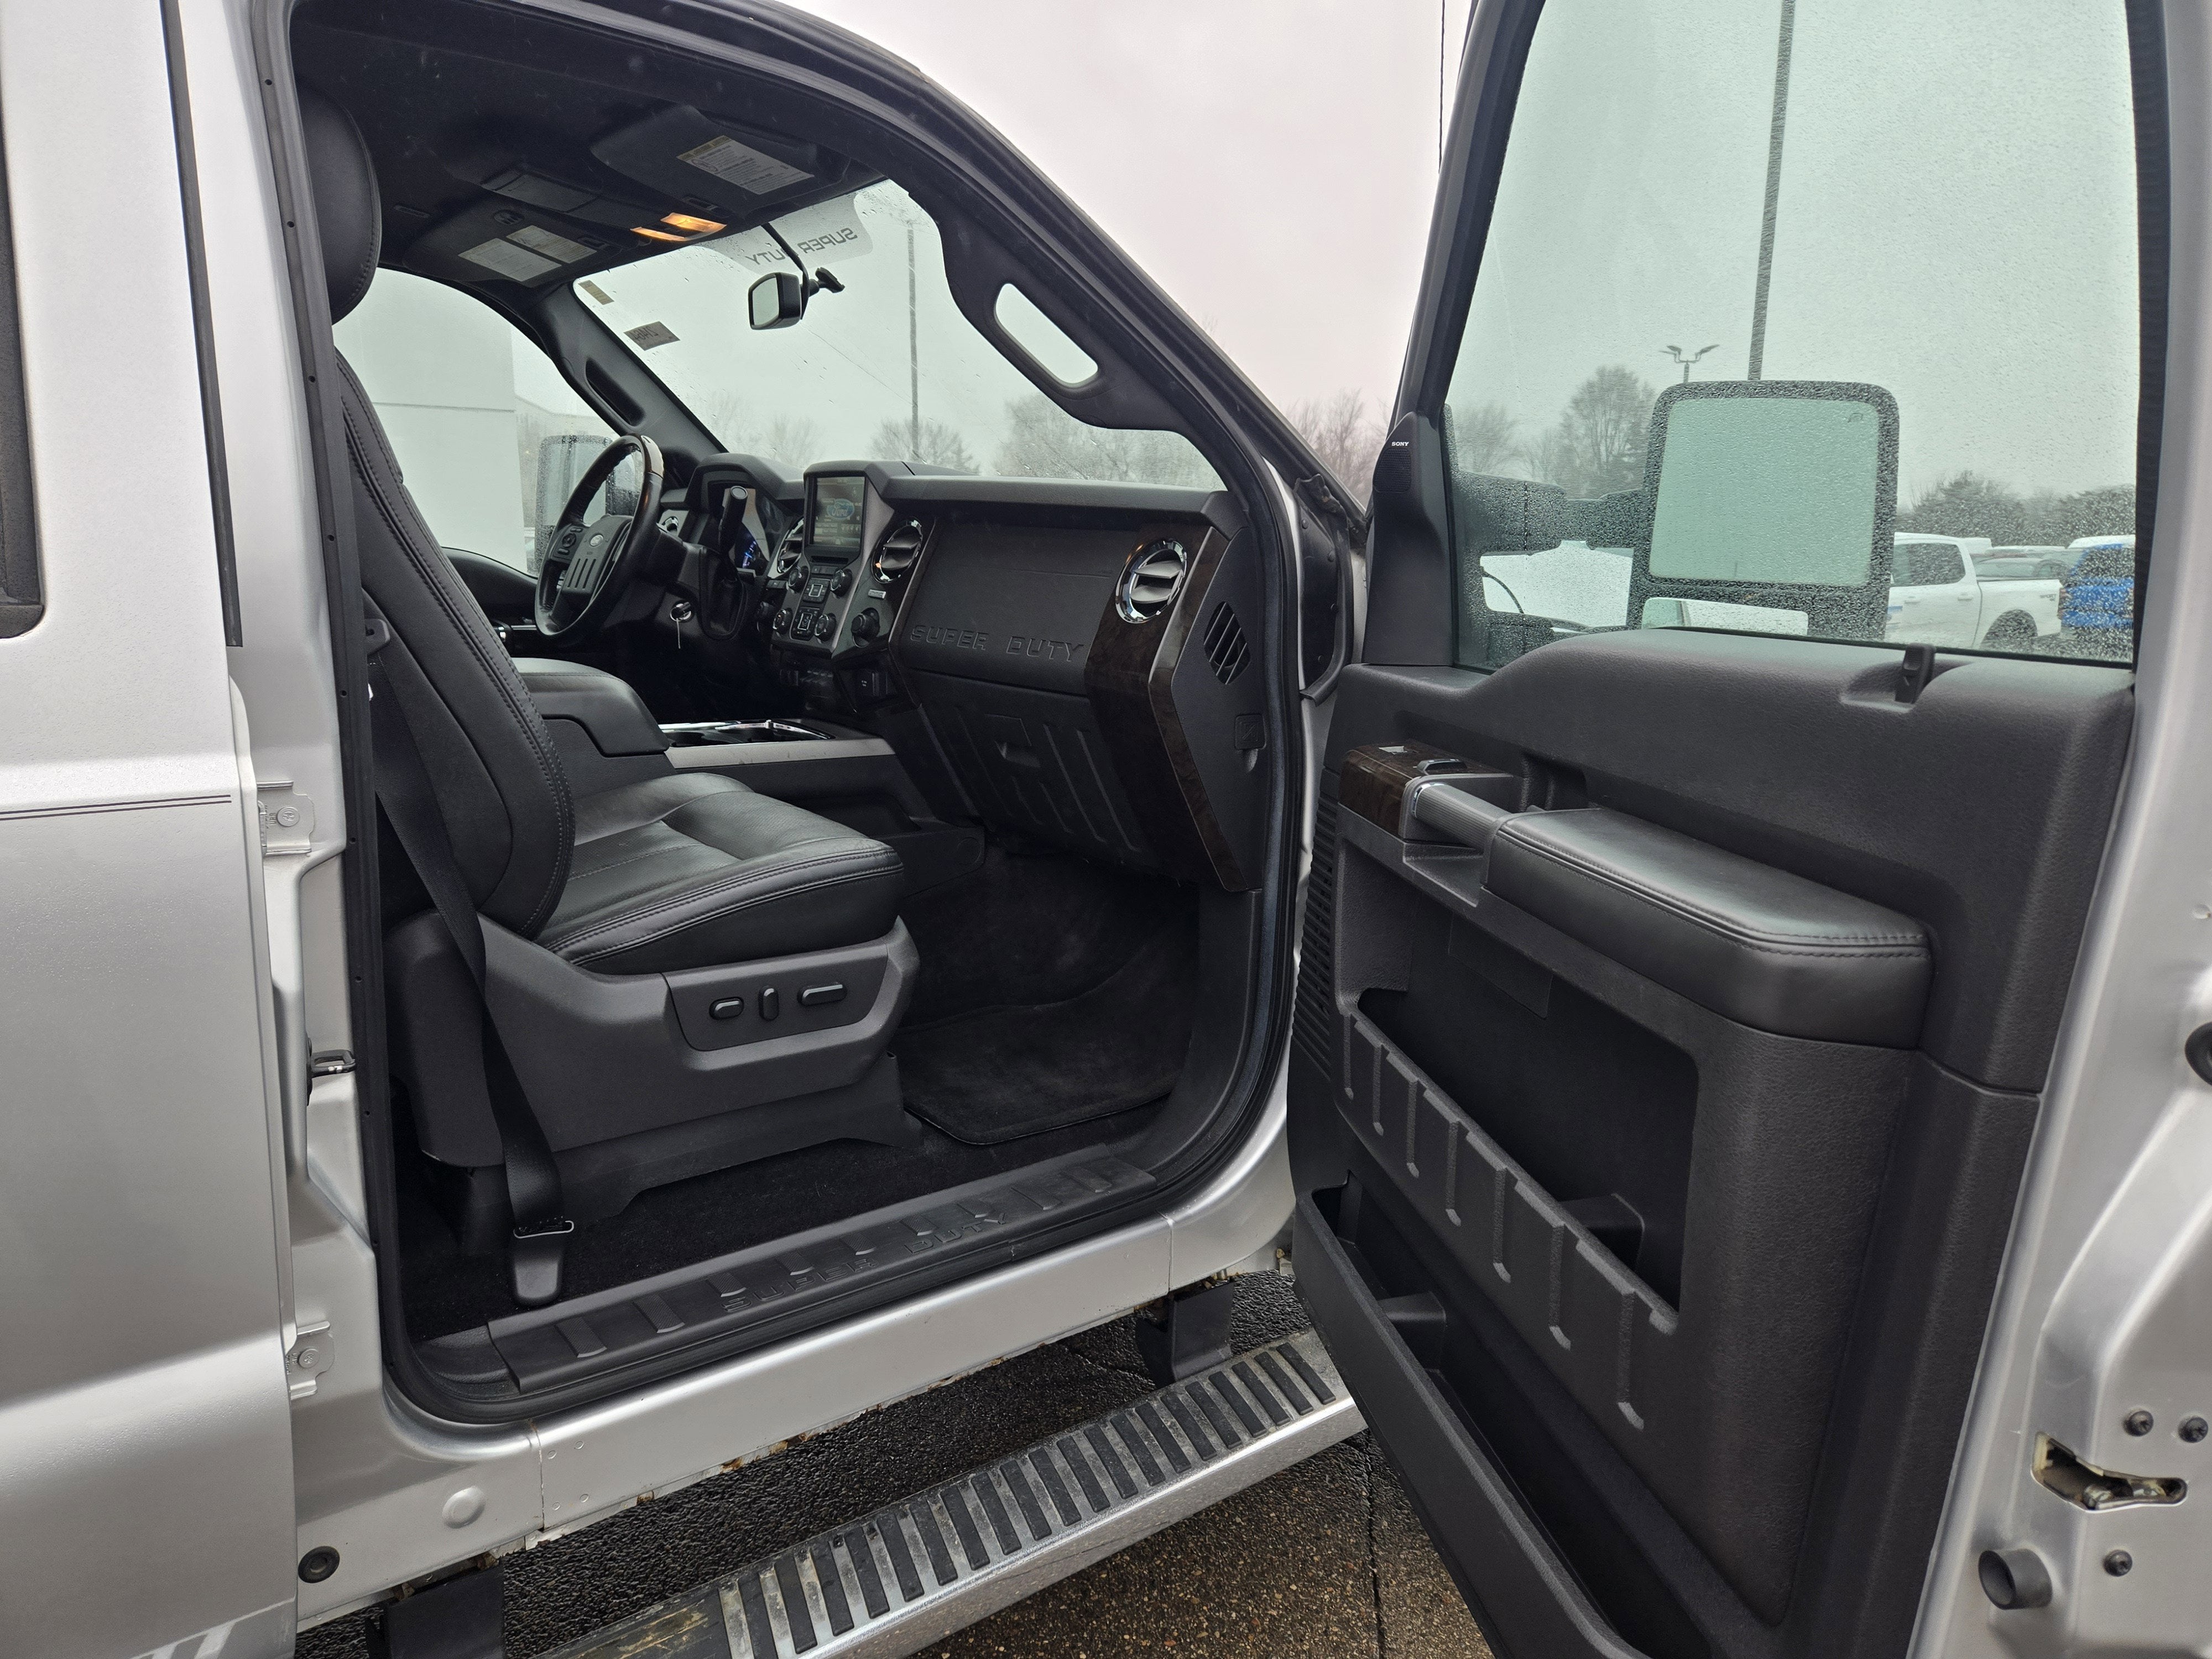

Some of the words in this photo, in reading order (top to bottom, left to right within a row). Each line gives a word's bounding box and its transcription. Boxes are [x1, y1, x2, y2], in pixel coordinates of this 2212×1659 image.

[910, 625, 989, 651] SUPER
[1006, 637, 1084, 662] DUTY
[721, 1259, 878, 1312] SUPER
[904, 1212, 1006, 1254] DUTY
